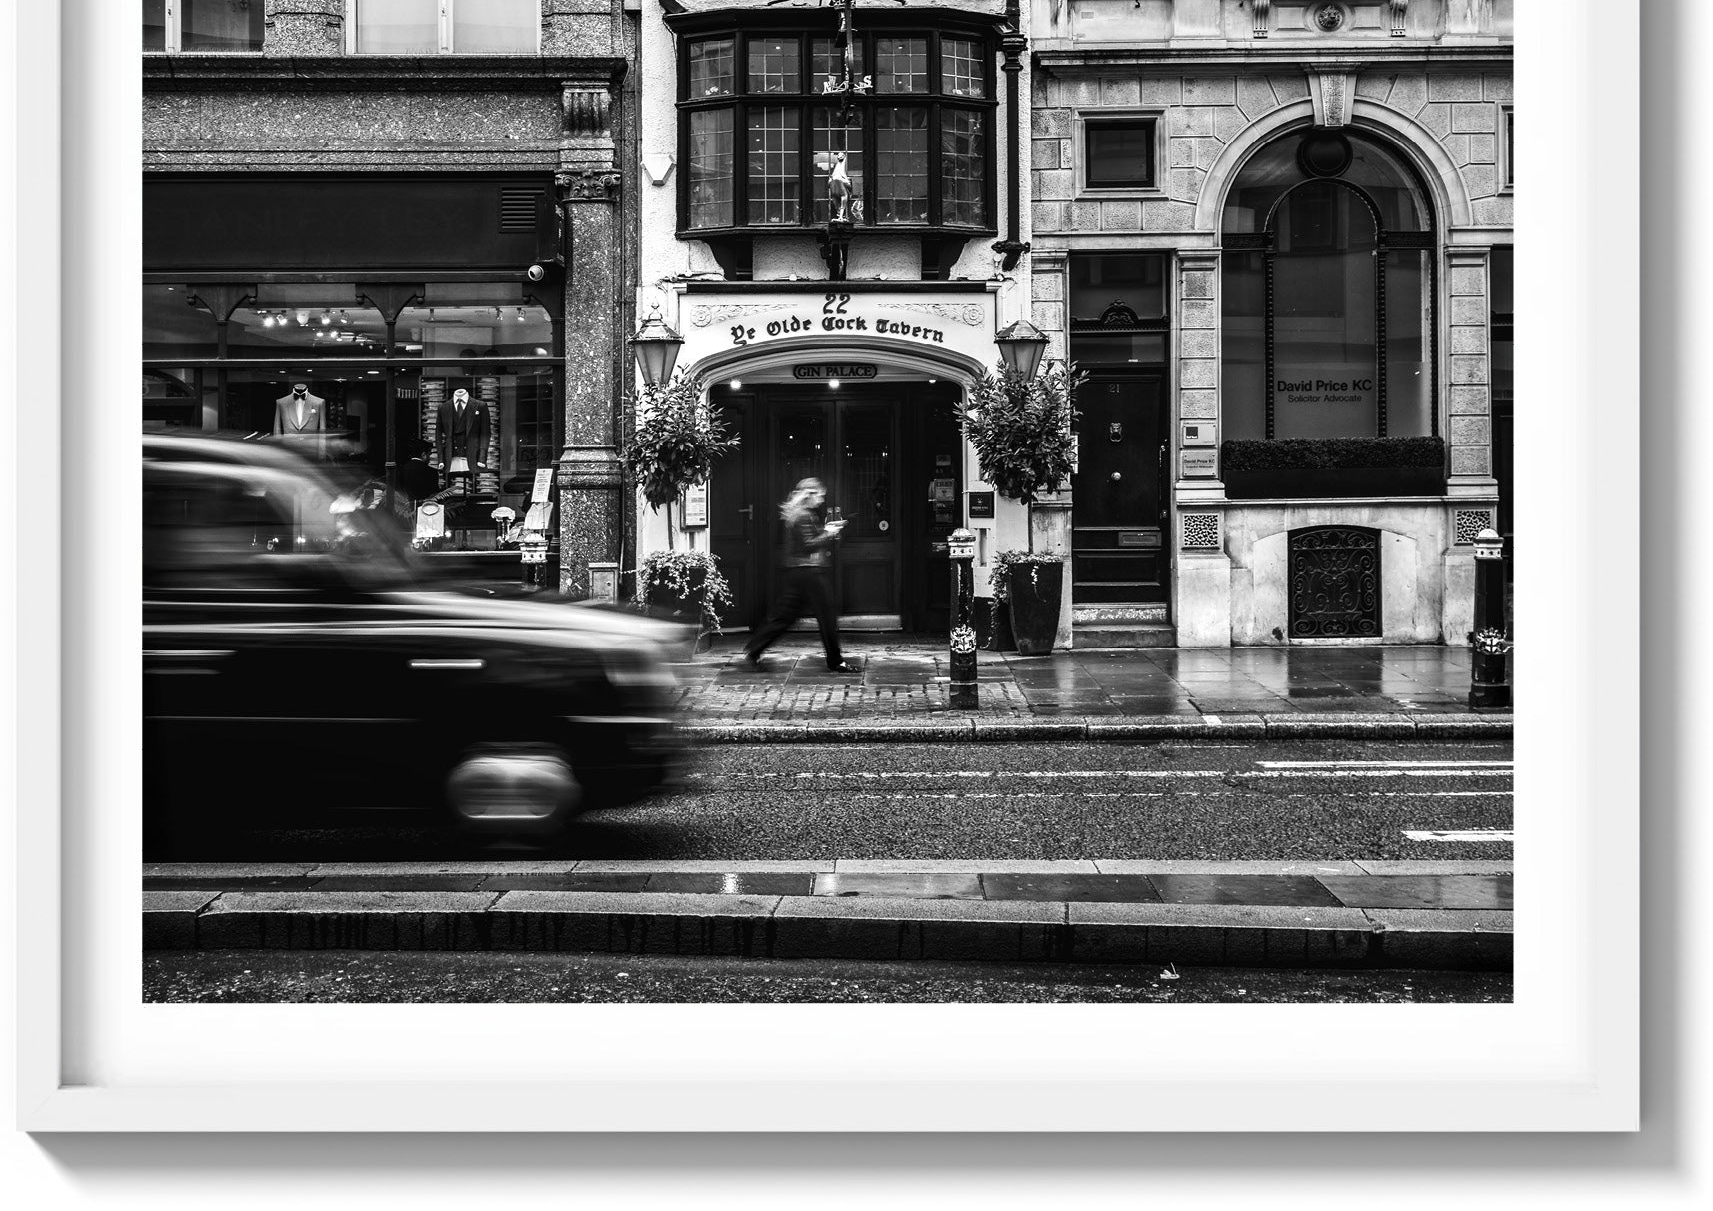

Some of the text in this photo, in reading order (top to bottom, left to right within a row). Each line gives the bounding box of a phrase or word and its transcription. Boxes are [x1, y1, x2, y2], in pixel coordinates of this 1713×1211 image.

[823, 293, 850, 314] 22
[731, 315, 944, 346] Ye Olde Cock Tavern
[798, 366, 873, 377] GIN PALACE
[1277, 378, 1373, 392] David Price KC
[1287, 394, 1362, 403] Solicitor Advocate
